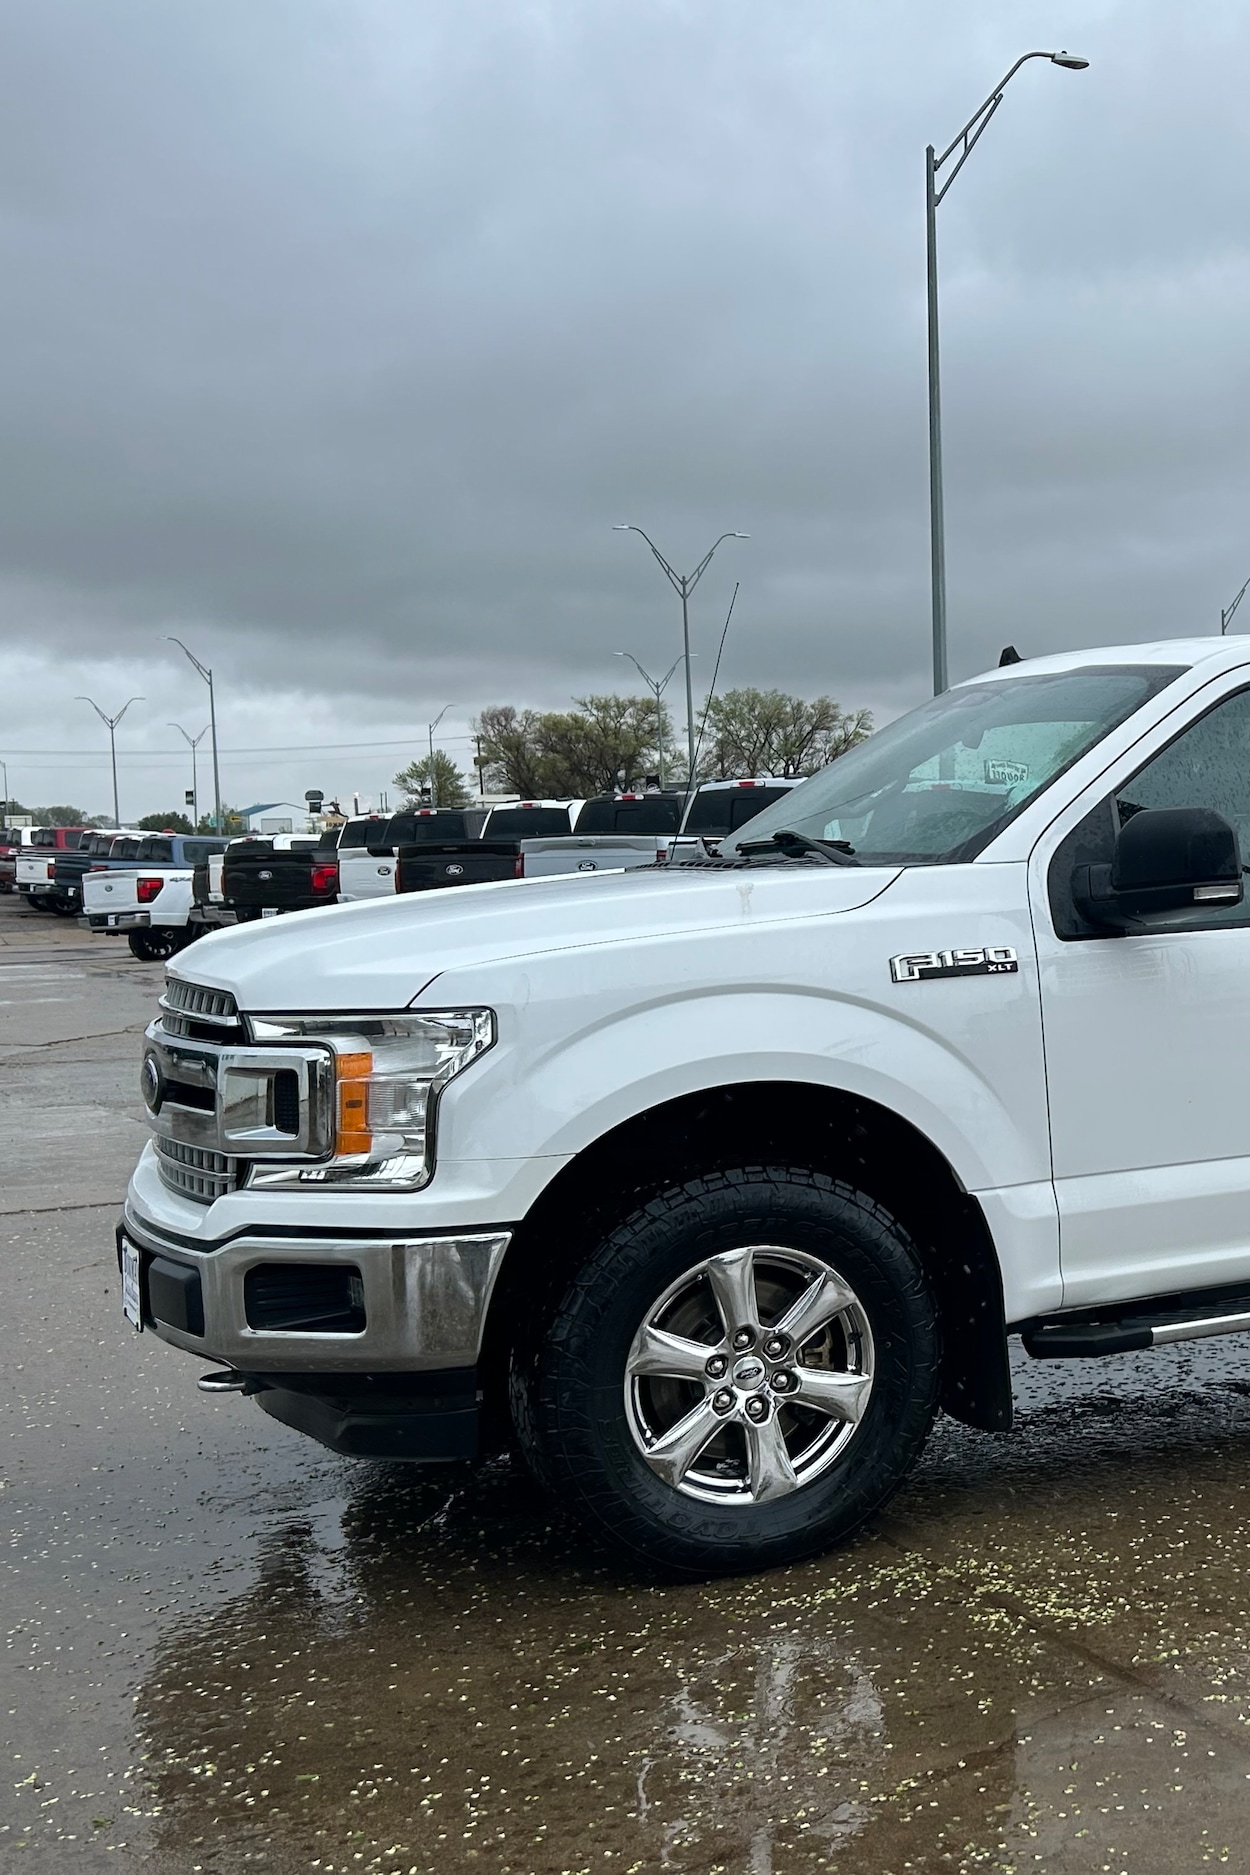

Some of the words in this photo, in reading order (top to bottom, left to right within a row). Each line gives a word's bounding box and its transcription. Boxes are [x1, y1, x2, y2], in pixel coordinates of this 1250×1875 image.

[987, 963, 1013, 972] XLT
[600, 1419, 667, 1517] TIRES
[667, 1511, 762, 1539] TOYO
